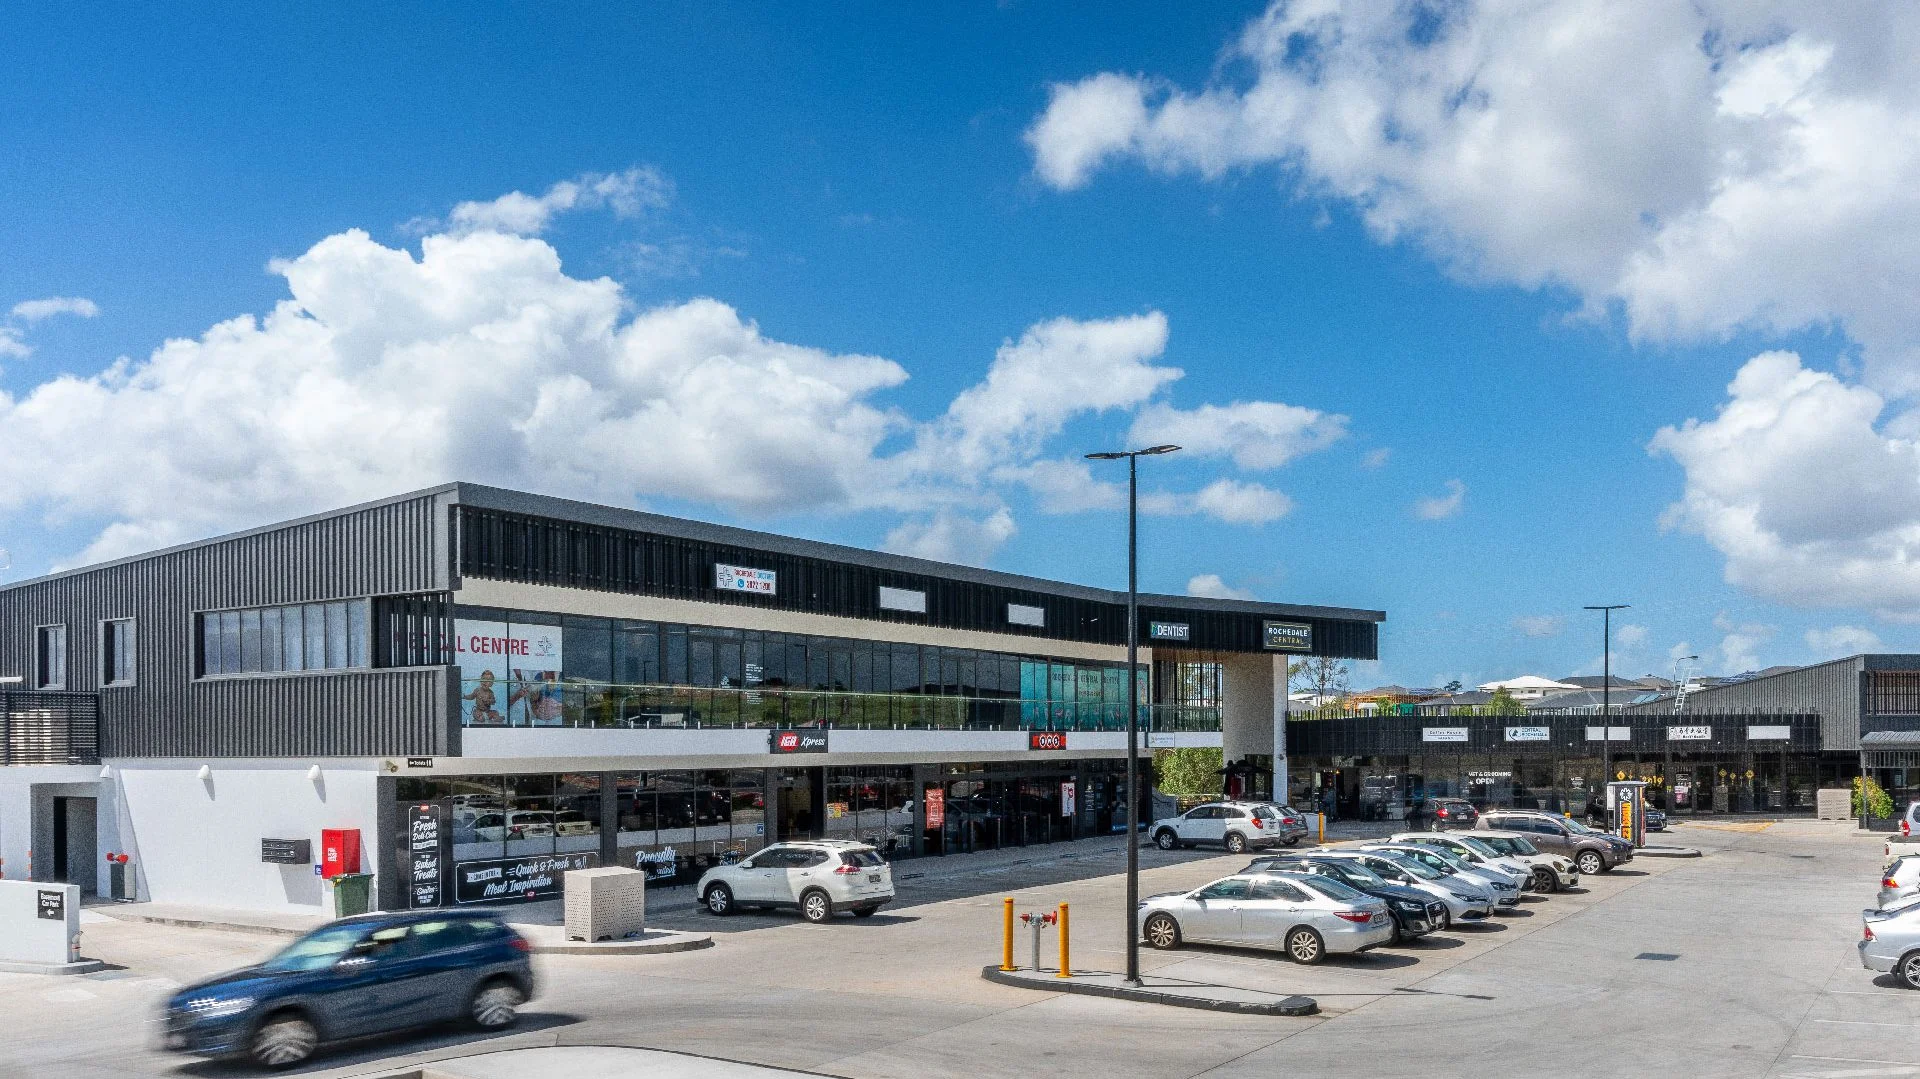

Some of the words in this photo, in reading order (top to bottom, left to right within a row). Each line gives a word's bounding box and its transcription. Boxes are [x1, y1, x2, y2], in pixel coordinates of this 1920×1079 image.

[1157, 624, 1189, 637] DENTIST
[1268, 627, 1308, 637] ROCHEDALE
[470, 635, 530, 656] CENTRE
[1273, 636, 1304, 645] CENTRAL
[780, 735, 799, 747] IGA
[800, 736, 826, 749] Xpress
[1475, 777, 1495, 785] OPEN
[413, 819, 437, 832] Fresh
[635, 845, 677, 867] Proudly
[515, 863, 539, 877] Quick
[547, 857, 570, 871] Fresh
[413, 868, 438, 881] Treats
[484, 881, 508, 896] Meal
[509, 874, 553, 893] Inspiration
